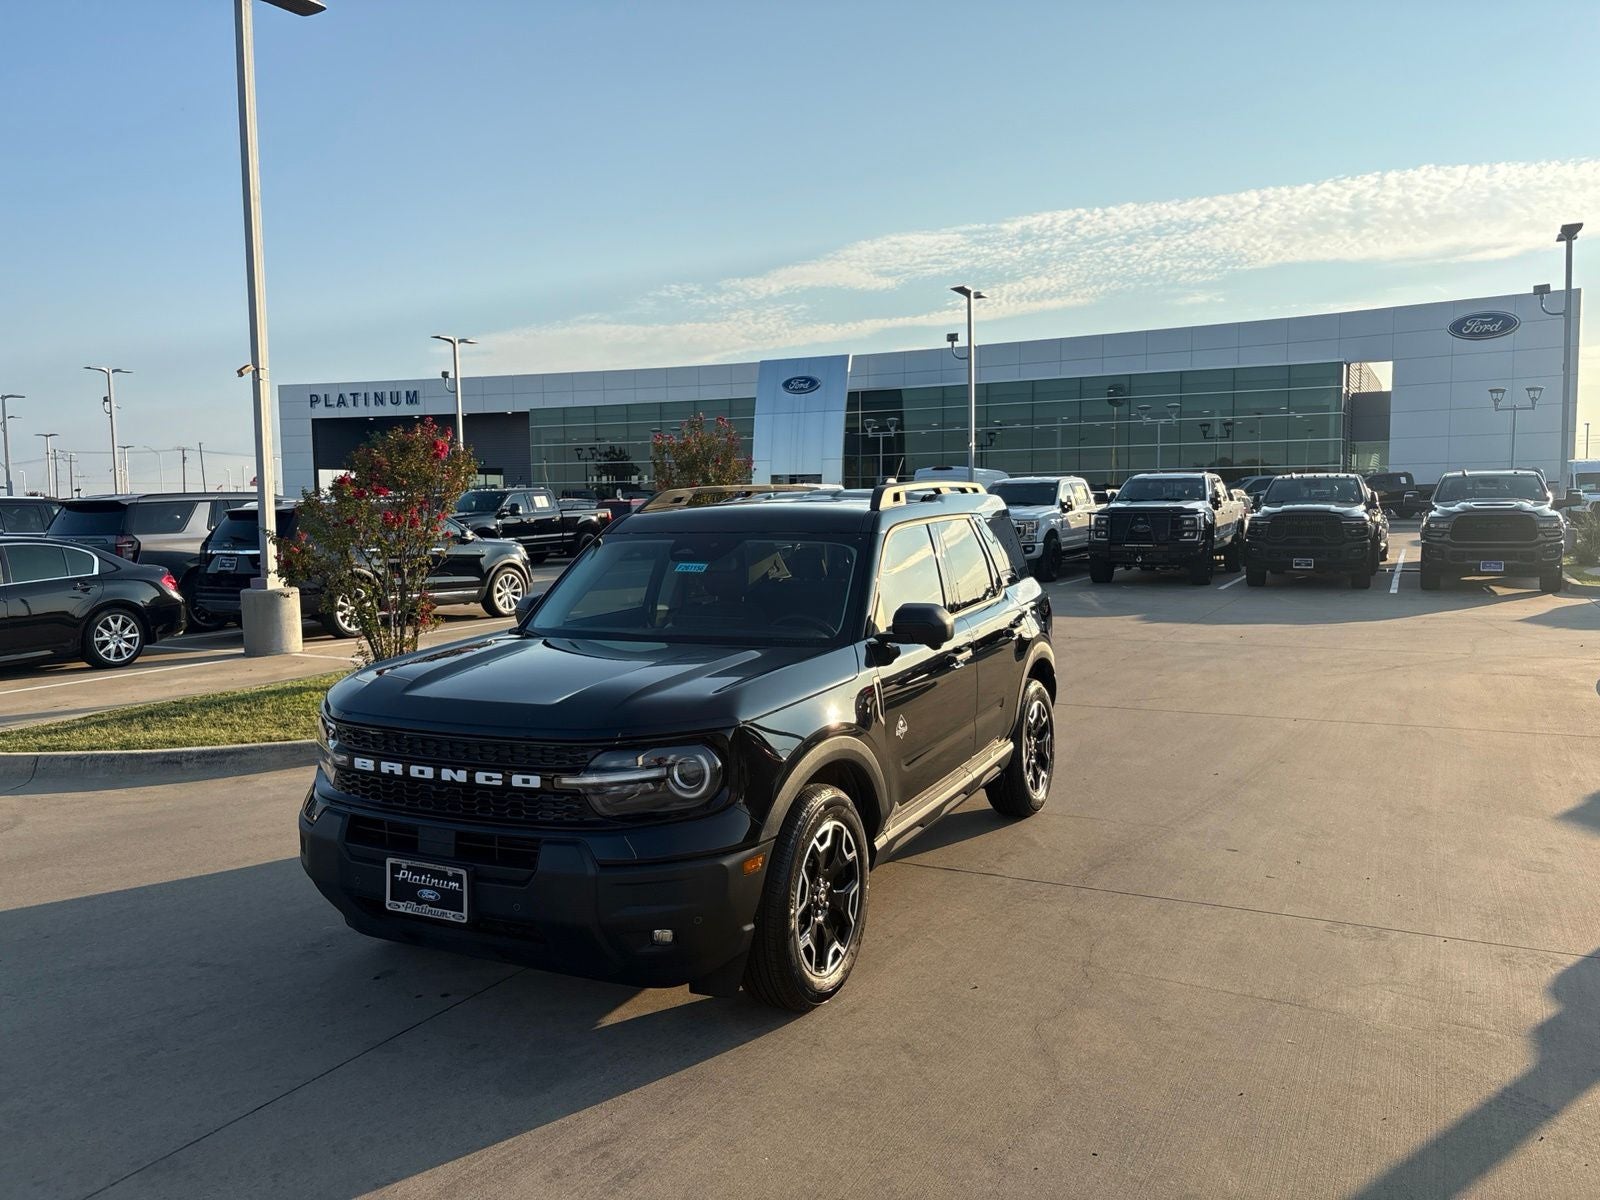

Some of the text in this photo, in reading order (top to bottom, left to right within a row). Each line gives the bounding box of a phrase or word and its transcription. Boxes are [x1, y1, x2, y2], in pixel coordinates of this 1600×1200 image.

[1462, 317, 1503, 333] Ford
[309, 390, 419, 408] PLATINUM
[354, 757, 541, 788] BRONCO
[394, 869, 463, 891] Platinum
[404, 901, 450, 918] Platinum
